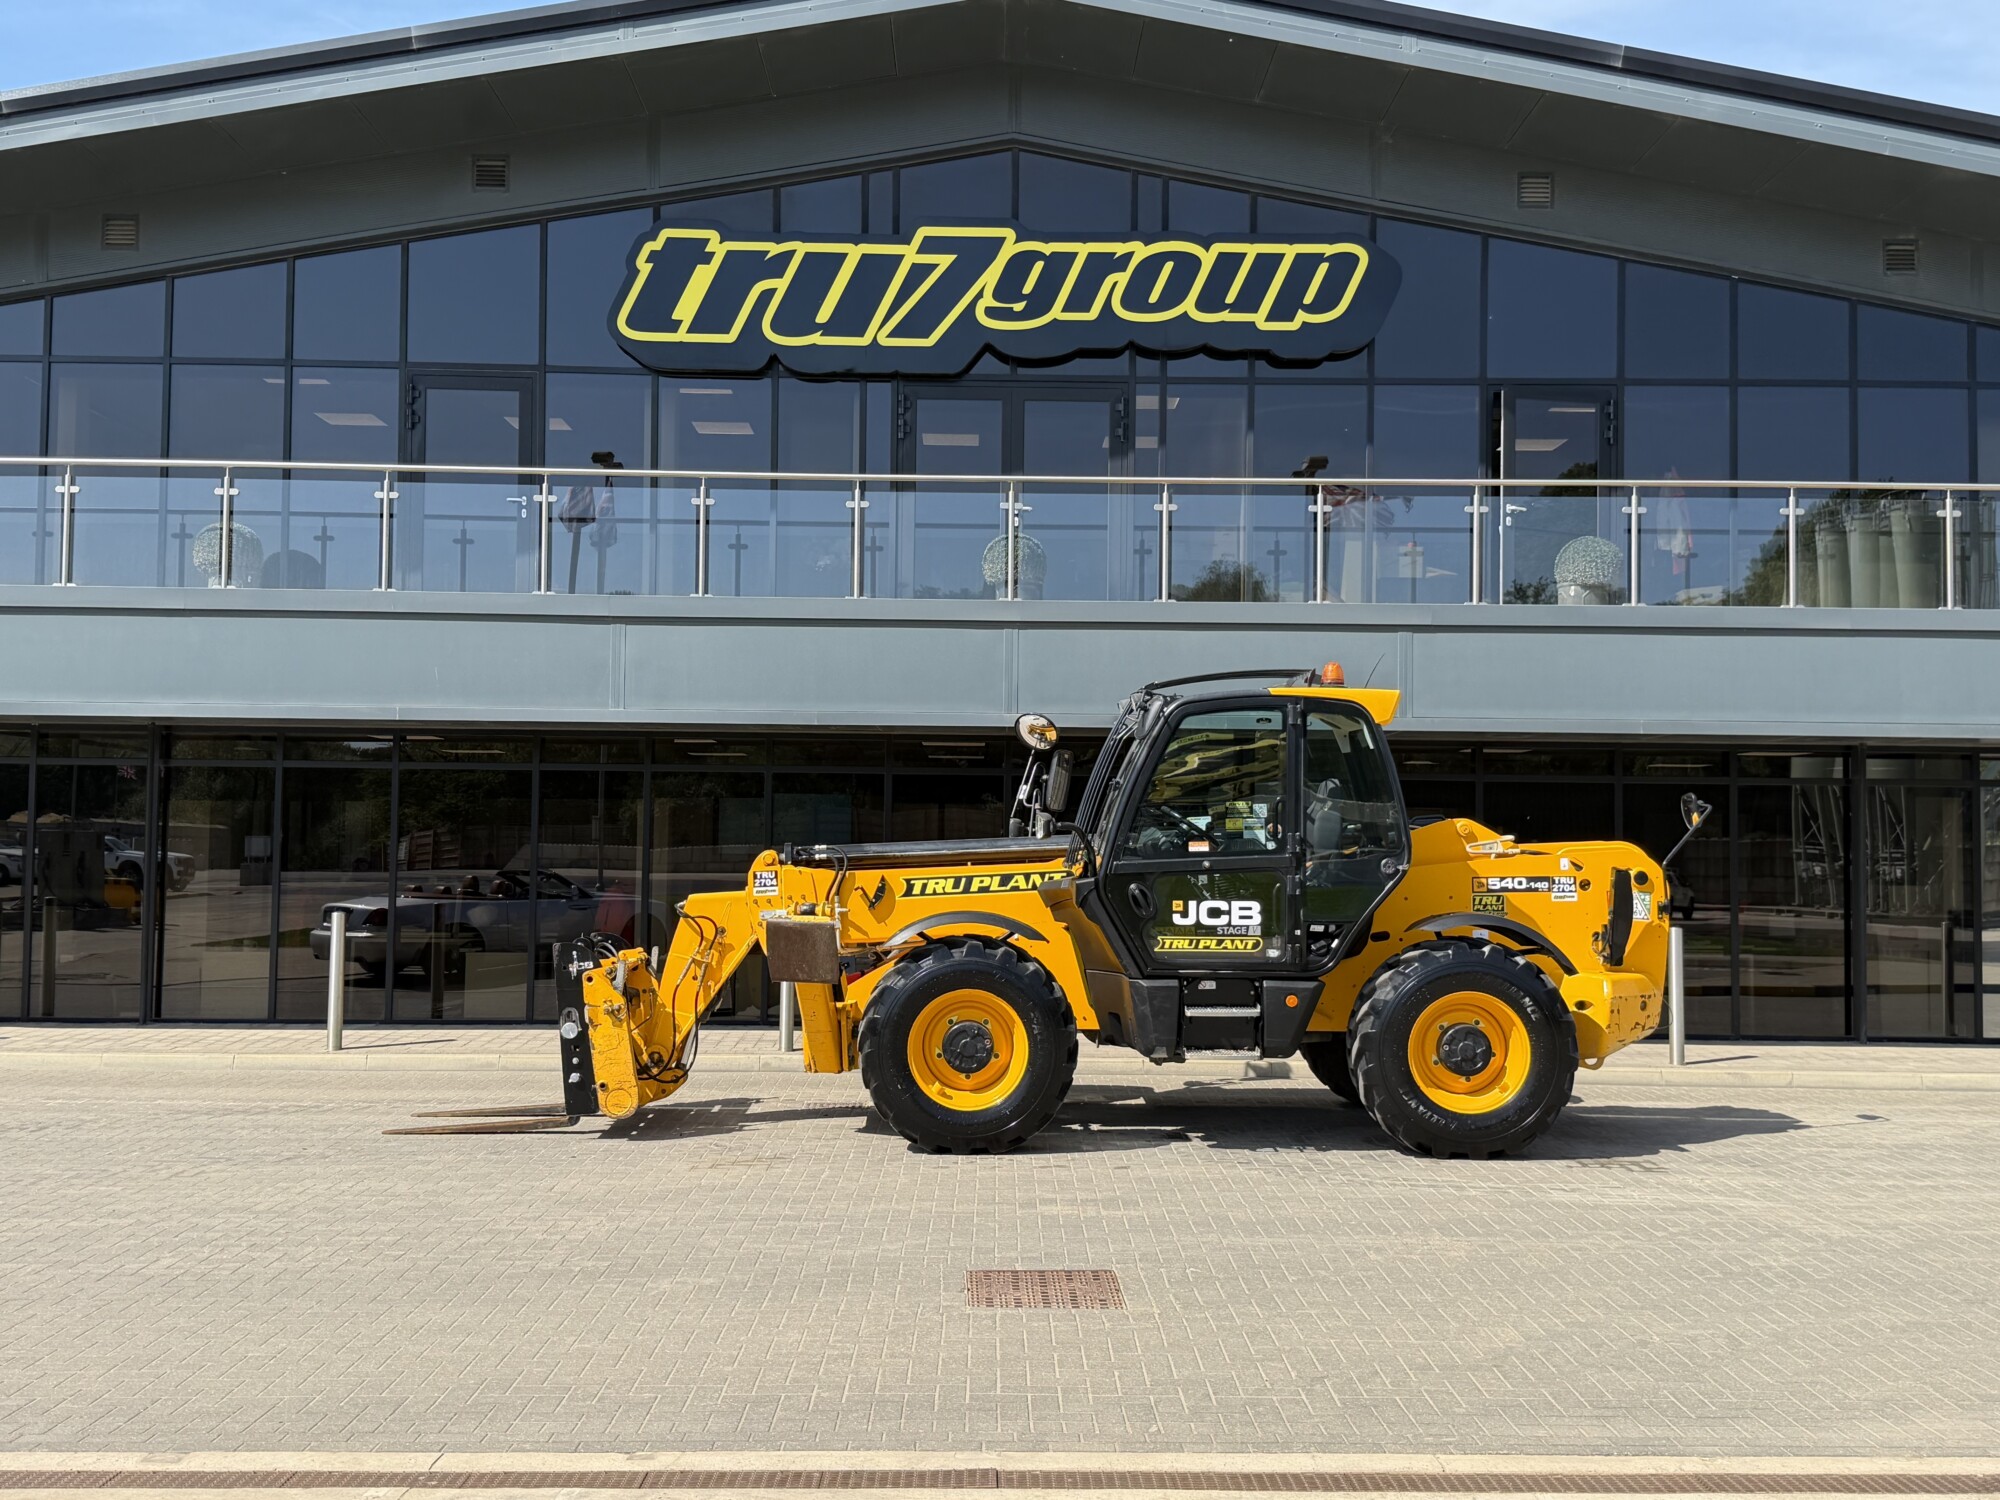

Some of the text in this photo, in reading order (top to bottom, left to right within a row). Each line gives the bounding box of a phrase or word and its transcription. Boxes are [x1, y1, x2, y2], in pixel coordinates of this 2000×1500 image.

[754, 871, 776, 879] TRU
[754, 879, 777, 887] 2704
[1487, 877, 1549, 890] 540-140
[1553, 876, 1575, 884] TRU
[909, 877, 966, 895] TRU
[1552, 884, 1576, 892] 2704
[1473, 896, 1503, 905] TRU
[1172, 900, 1262, 926] JCB
[1216, 926, 1247, 935] STAGE
[1163, 939, 1257, 950] TRU PLANT
